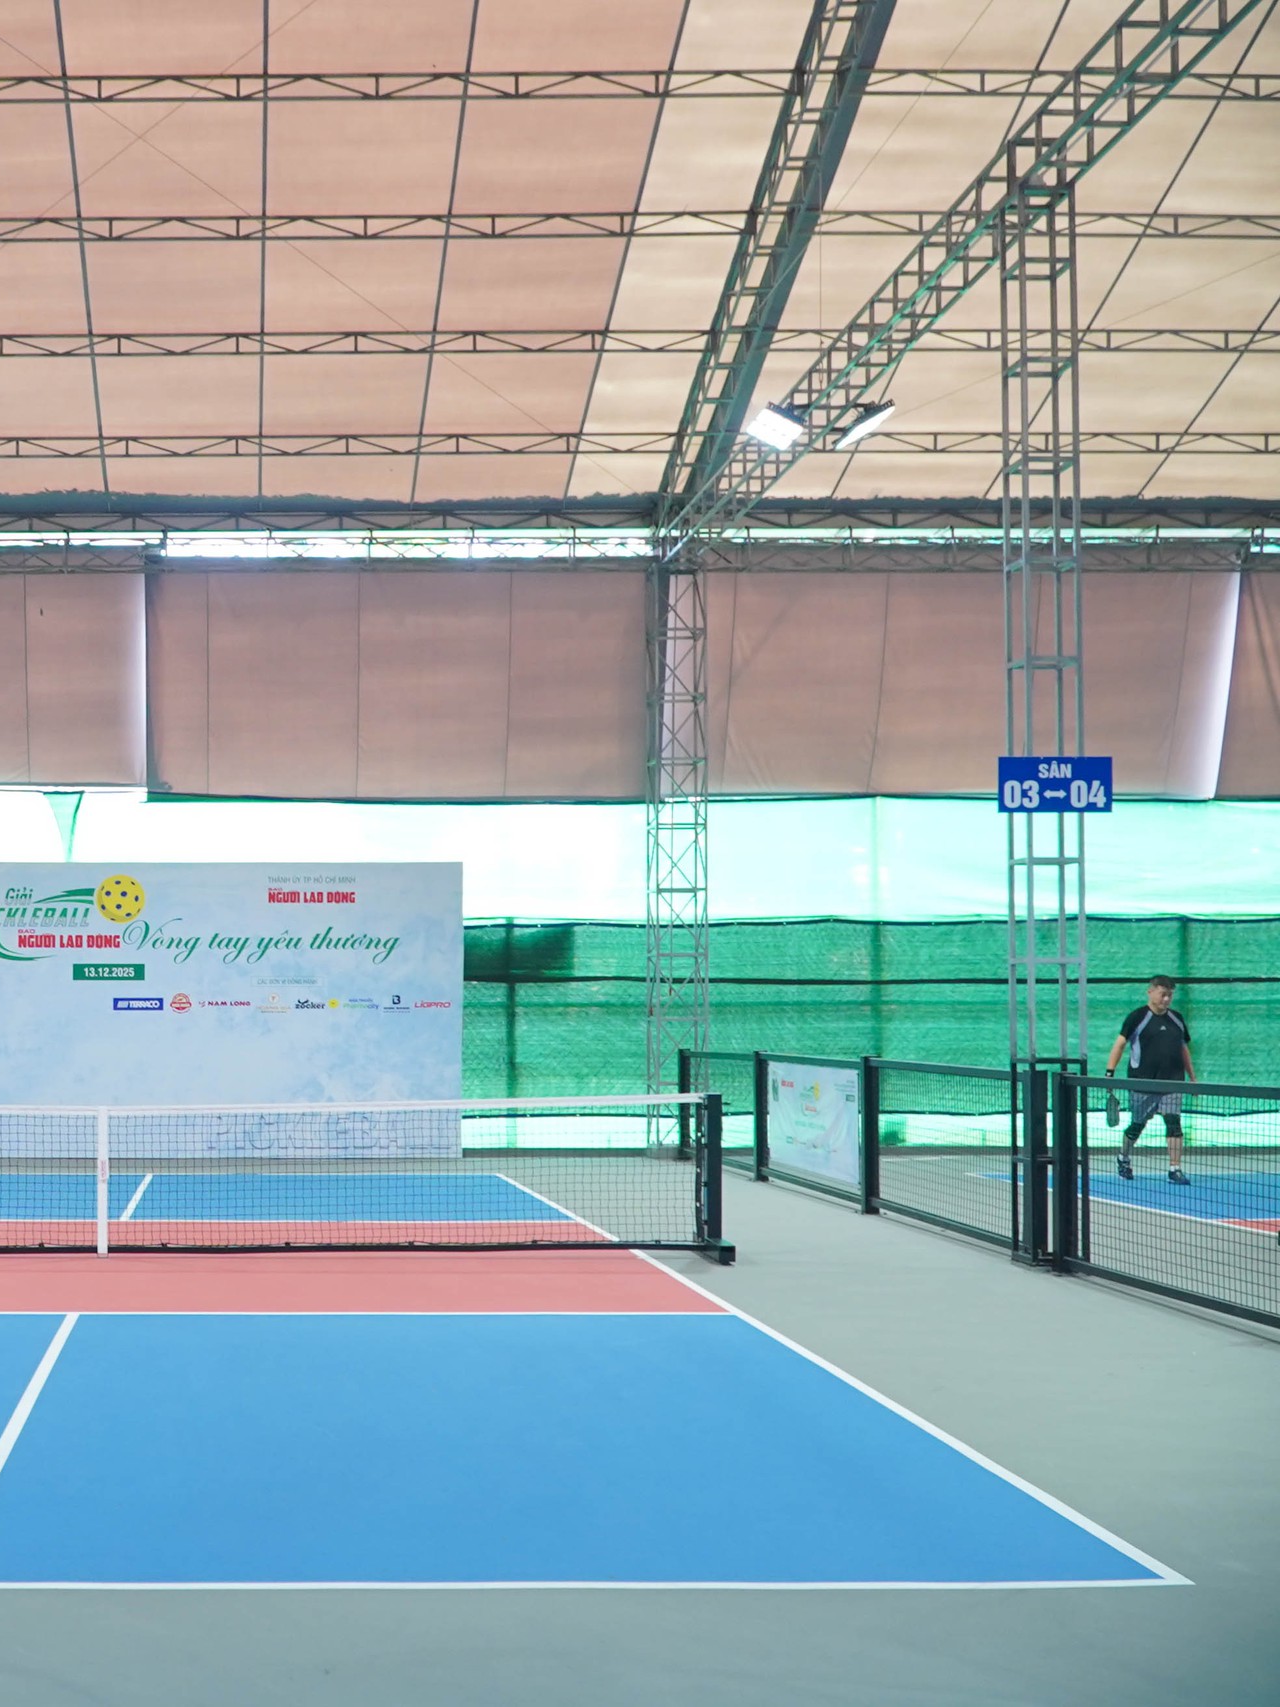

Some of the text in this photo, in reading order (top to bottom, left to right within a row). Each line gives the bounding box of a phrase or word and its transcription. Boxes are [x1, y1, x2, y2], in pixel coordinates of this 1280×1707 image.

[1038, 760, 1072, 778] SÂN
[1004, 780, 1106, 808] 03 04
[5, 887, 34, 905] Giải
[304, 892, 323, 903] LAO
[60, 935, 83, 948] LAO
[122, 918, 401, 964] Vòng tay yêu thương
[84, 967, 135, 977] 13.12.2025
